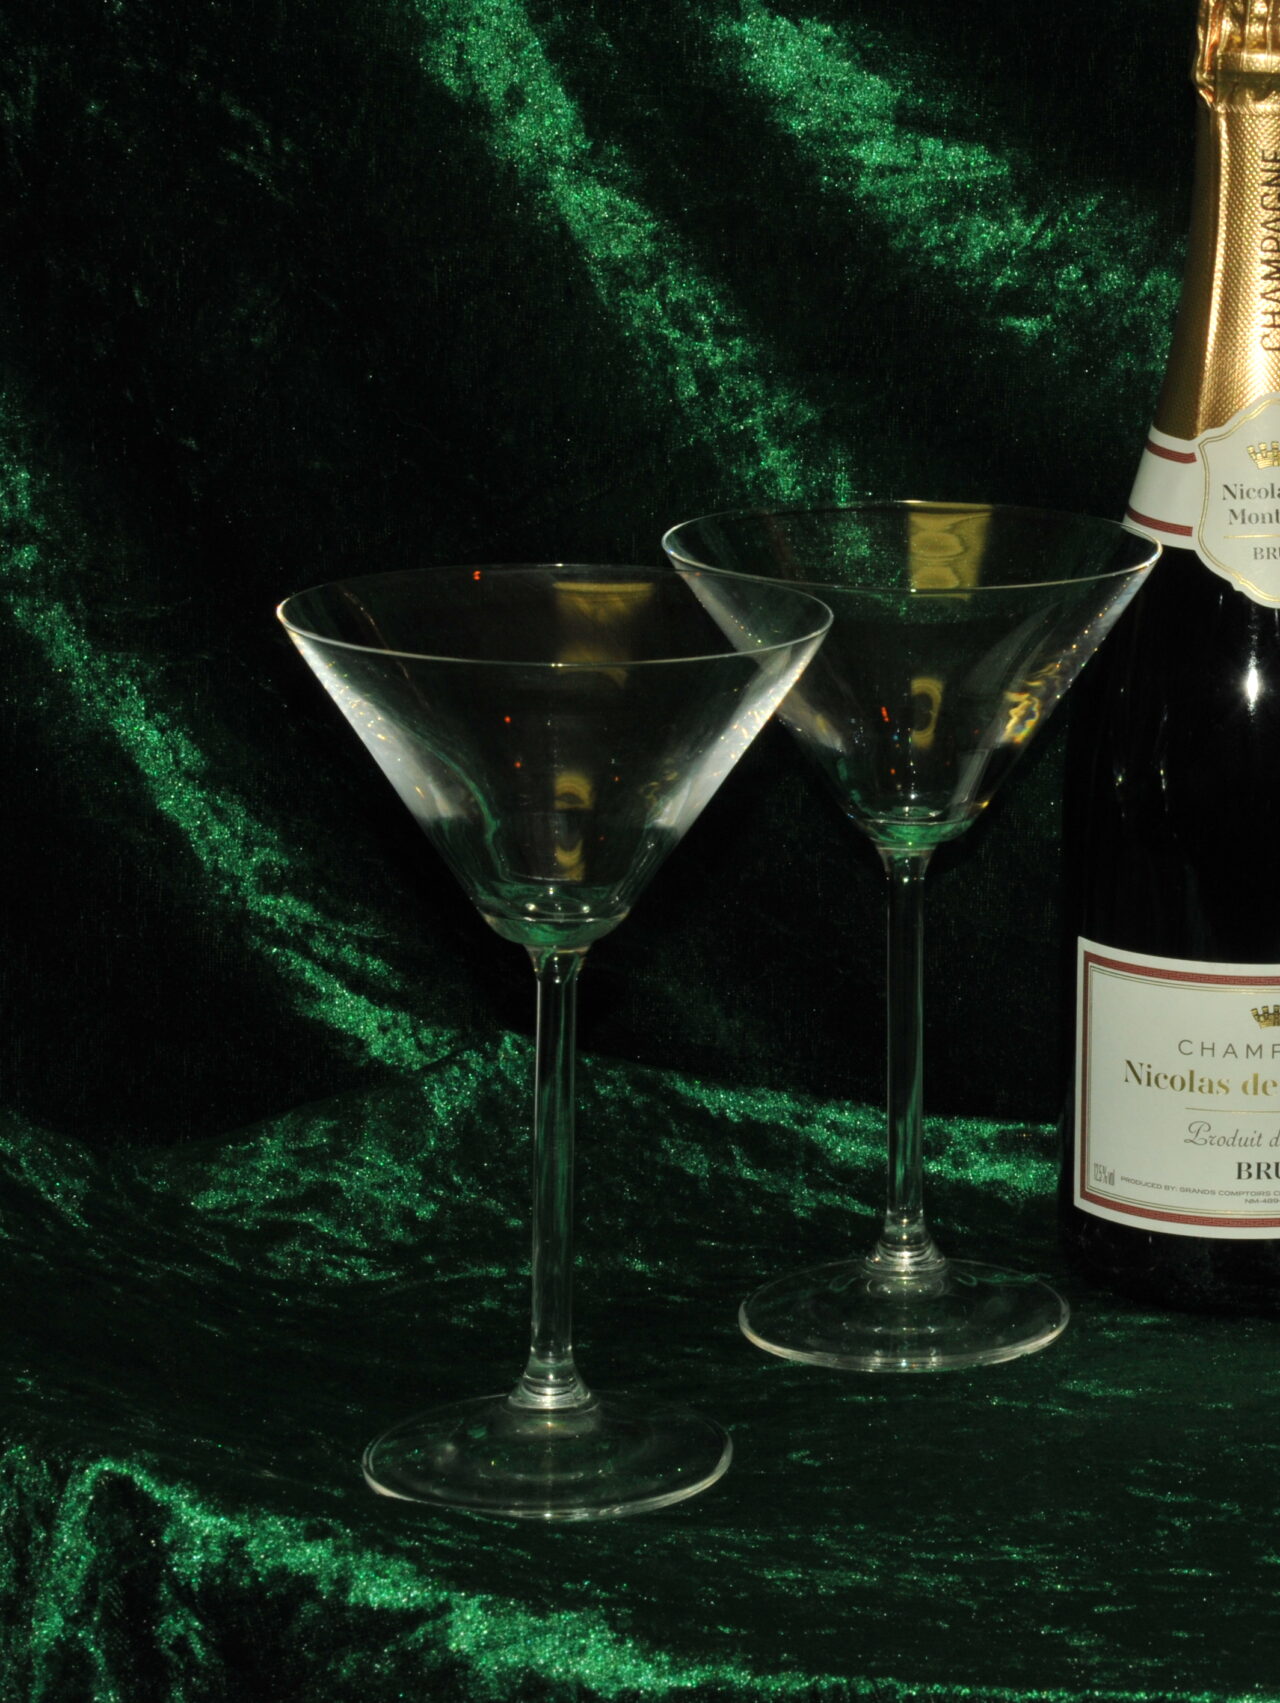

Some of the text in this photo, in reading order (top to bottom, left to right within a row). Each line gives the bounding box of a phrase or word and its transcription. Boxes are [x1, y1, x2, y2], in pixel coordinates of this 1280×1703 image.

[1124, 1059, 1231, 1096] Nicolas
[1241, 1073, 1278, 1097] de
[1183, 1120, 1263, 1149] Produit
[1120, 1175, 1163, 1190] PRODUCED
[1179, 1186, 1216, 1196] GRANDS
[1218, 1189, 1272, 1197] COMPTOIRS
